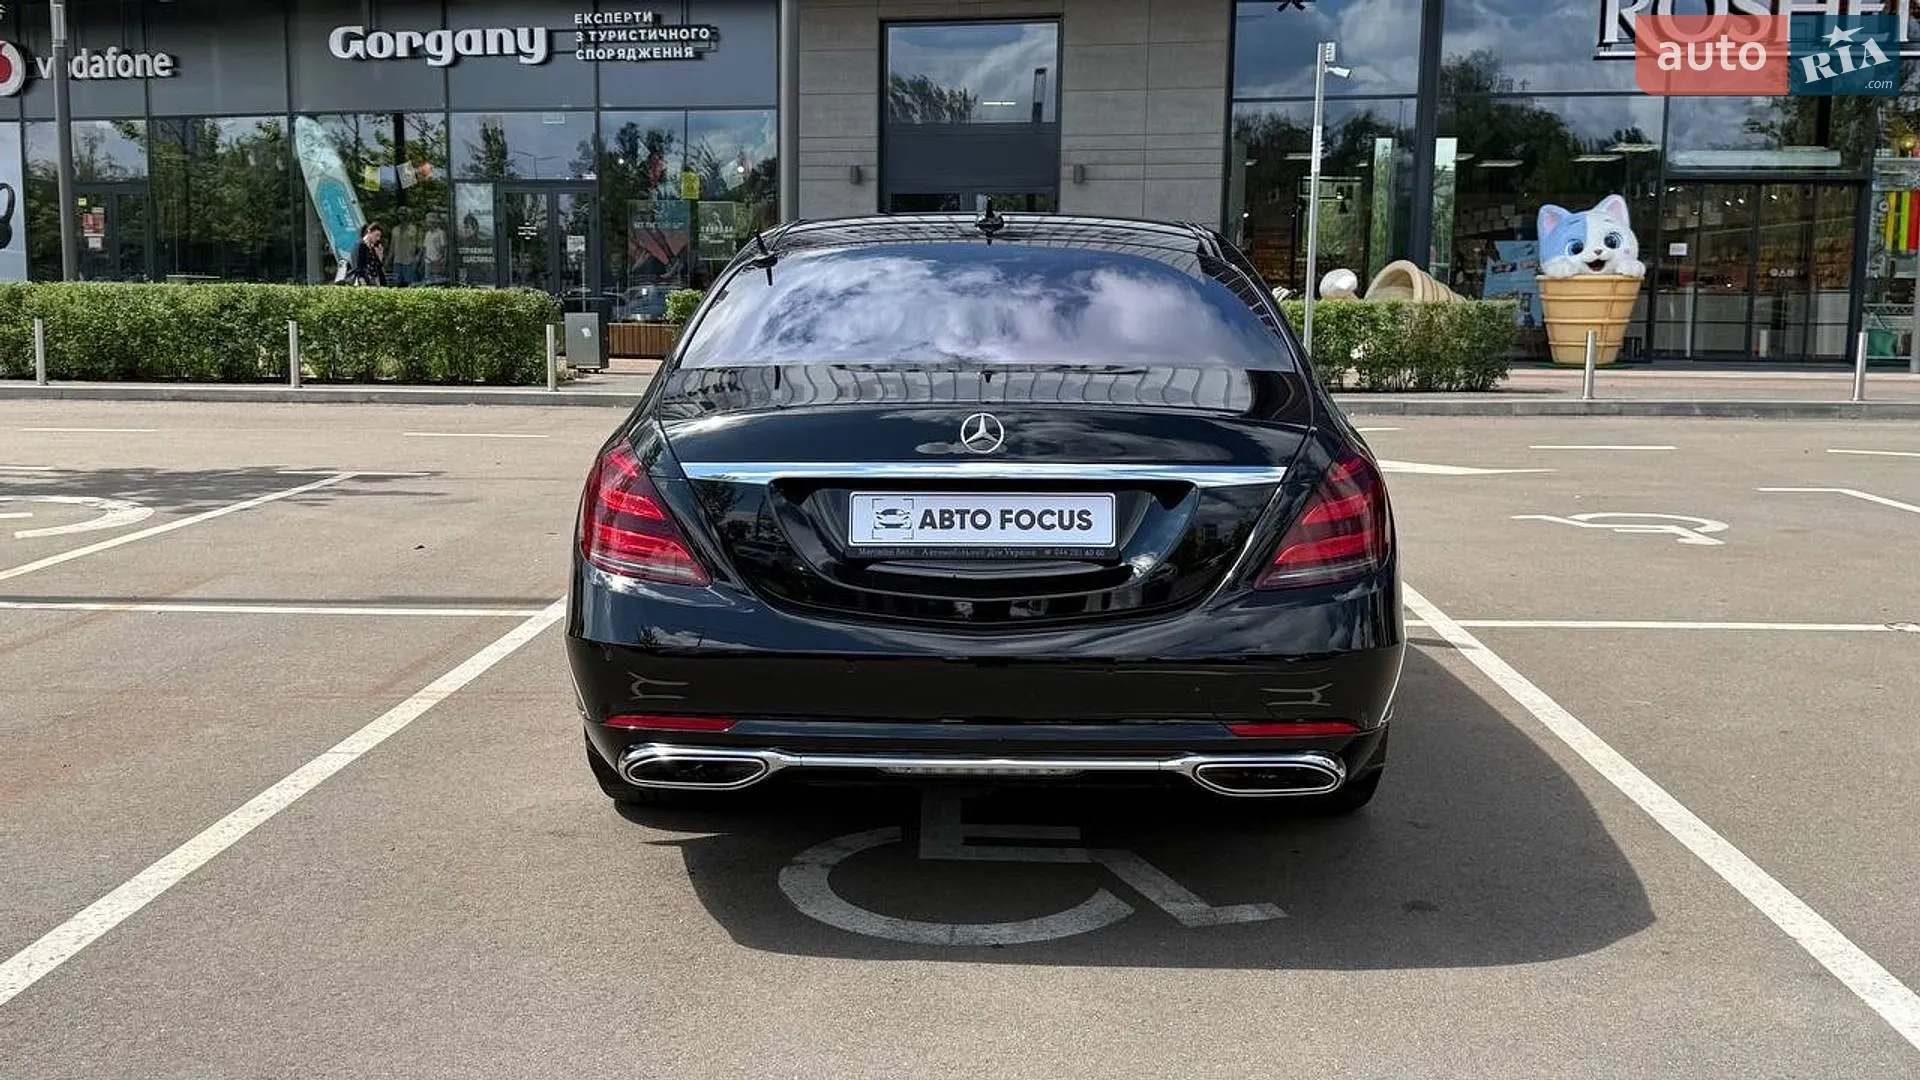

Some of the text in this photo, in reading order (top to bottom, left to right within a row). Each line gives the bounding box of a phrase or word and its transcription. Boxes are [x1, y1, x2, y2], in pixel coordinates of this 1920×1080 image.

[574, 11, 653, 25] ЕКСПЕРТИ
[588, 28, 711, 42] ТУРИСТИЧНОГО
[328, 25, 549, 67] Gorgany
[575, 46, 695, 61] СПОРЯДЖЕННЯ
[36, 46, 174, 80] vdafone
[918, 508, 1093, 531] АВТО FOCUS
